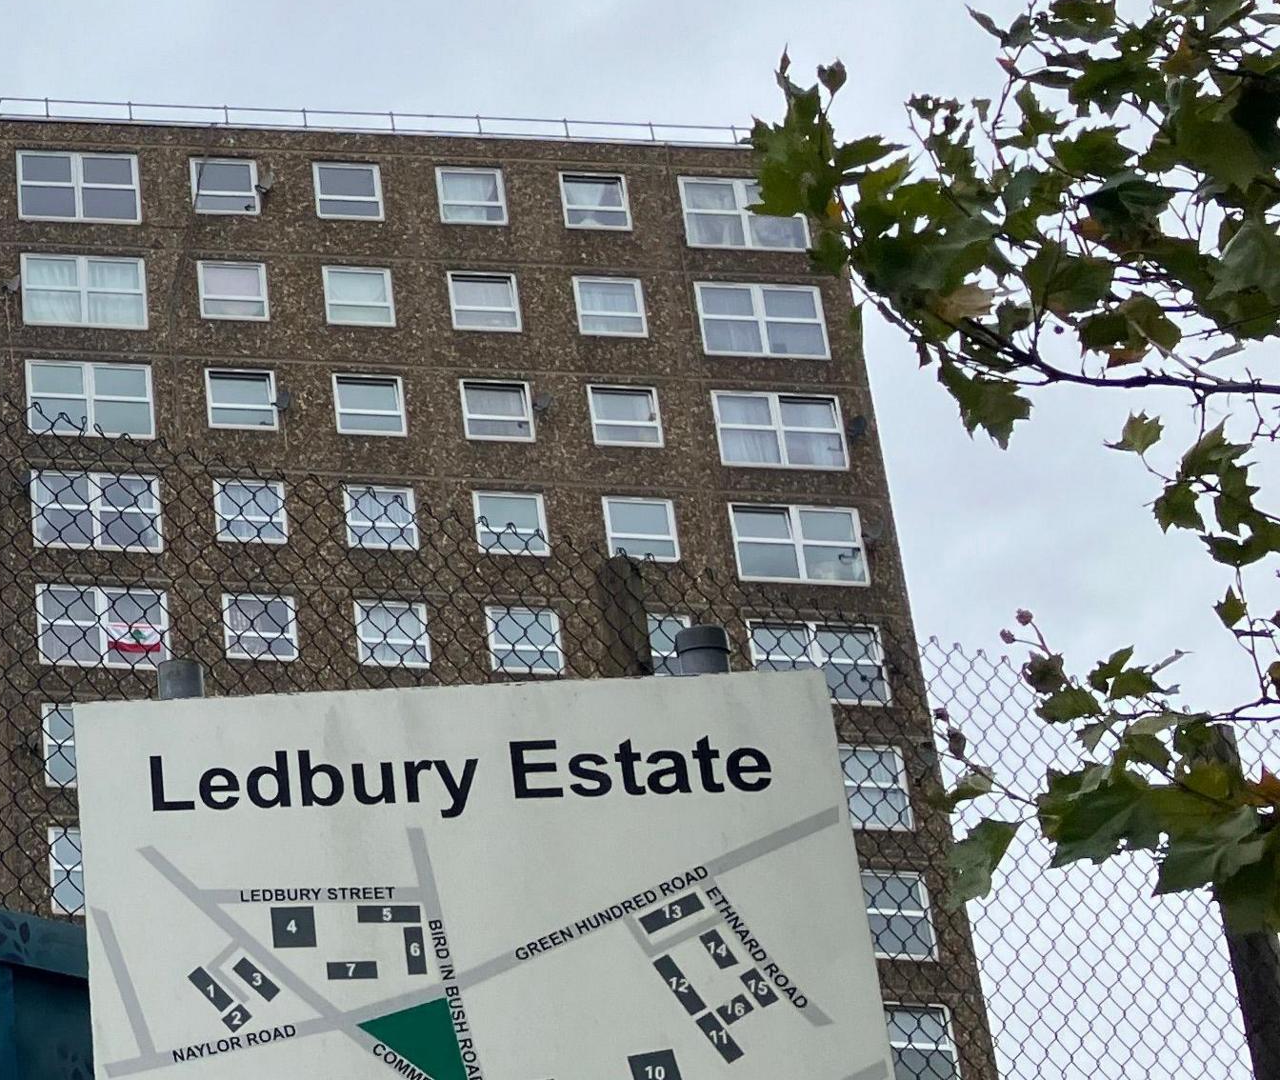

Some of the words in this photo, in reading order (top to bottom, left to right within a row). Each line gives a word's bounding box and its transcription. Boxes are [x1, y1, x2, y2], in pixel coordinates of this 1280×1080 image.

[149, 750, 479, 819] Ledbury
[509, 736, 772, 799] Estate
[240, 888, 321, 903] LEDBURY
[327, 886, 395, 901] STREET
[382, 908, 392, 921] 5
[515, 926, 574, 961] GREEN
[575, 890, 657, 935] HUNDRED
[659, 865, 709, 898] ROAD
[661, 904, 682, 919] 13
[286, 920, 297, 934] 4
[428, 919, 450, 960] BIRD
[410, 942, 420, 957] 6
[705, 886, 767, 963] ETHNARD
[763, 963, 808, 1010] ROAD
[707, 941, 727, 957] 14
[345, 963, 356, 977] 7
[439, 964, 456, 981] IN
[252, 972, 262, 987] 3
[669, 976, 688, 993] 12
[747, 978, 768, 995] 15
[206, 984, 215, 998] 1
[445, 985, 469, 1034] BUSH
[724, 1003, 745, 1017] 16
[231, 1011, 242, 1026] 2
[172, 1035, 242, 1063] NAYLOR
[247, 1023, 296, 1047] ROAD
[709, 1029, 728, 1044] 11
[644, 1065, 666, 1080] 10
